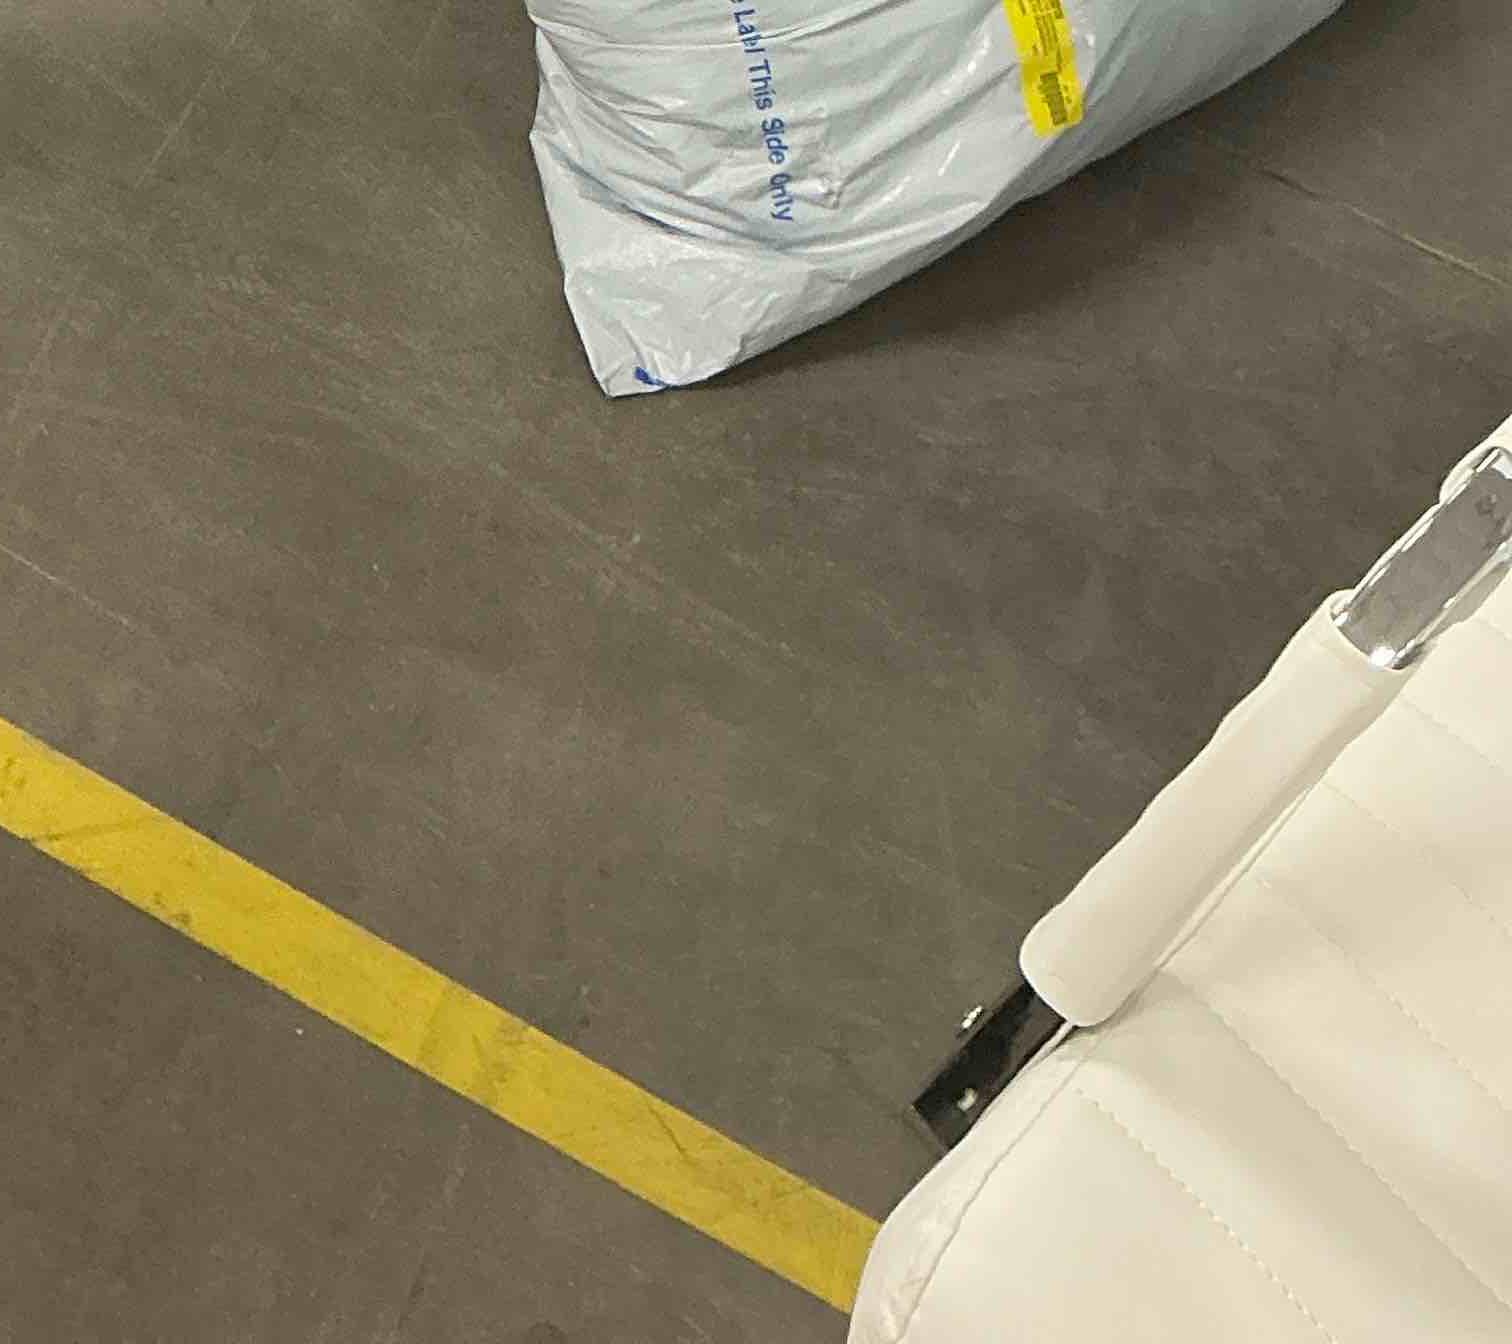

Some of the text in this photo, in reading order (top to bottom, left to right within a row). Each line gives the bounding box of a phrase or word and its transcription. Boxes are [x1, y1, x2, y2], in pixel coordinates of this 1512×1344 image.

[733, 9, 765, 53] Lal
[749, 59, 776, 110] This
[761, 118, 788, 164] Side
[770, 173, 794, 221] Only
